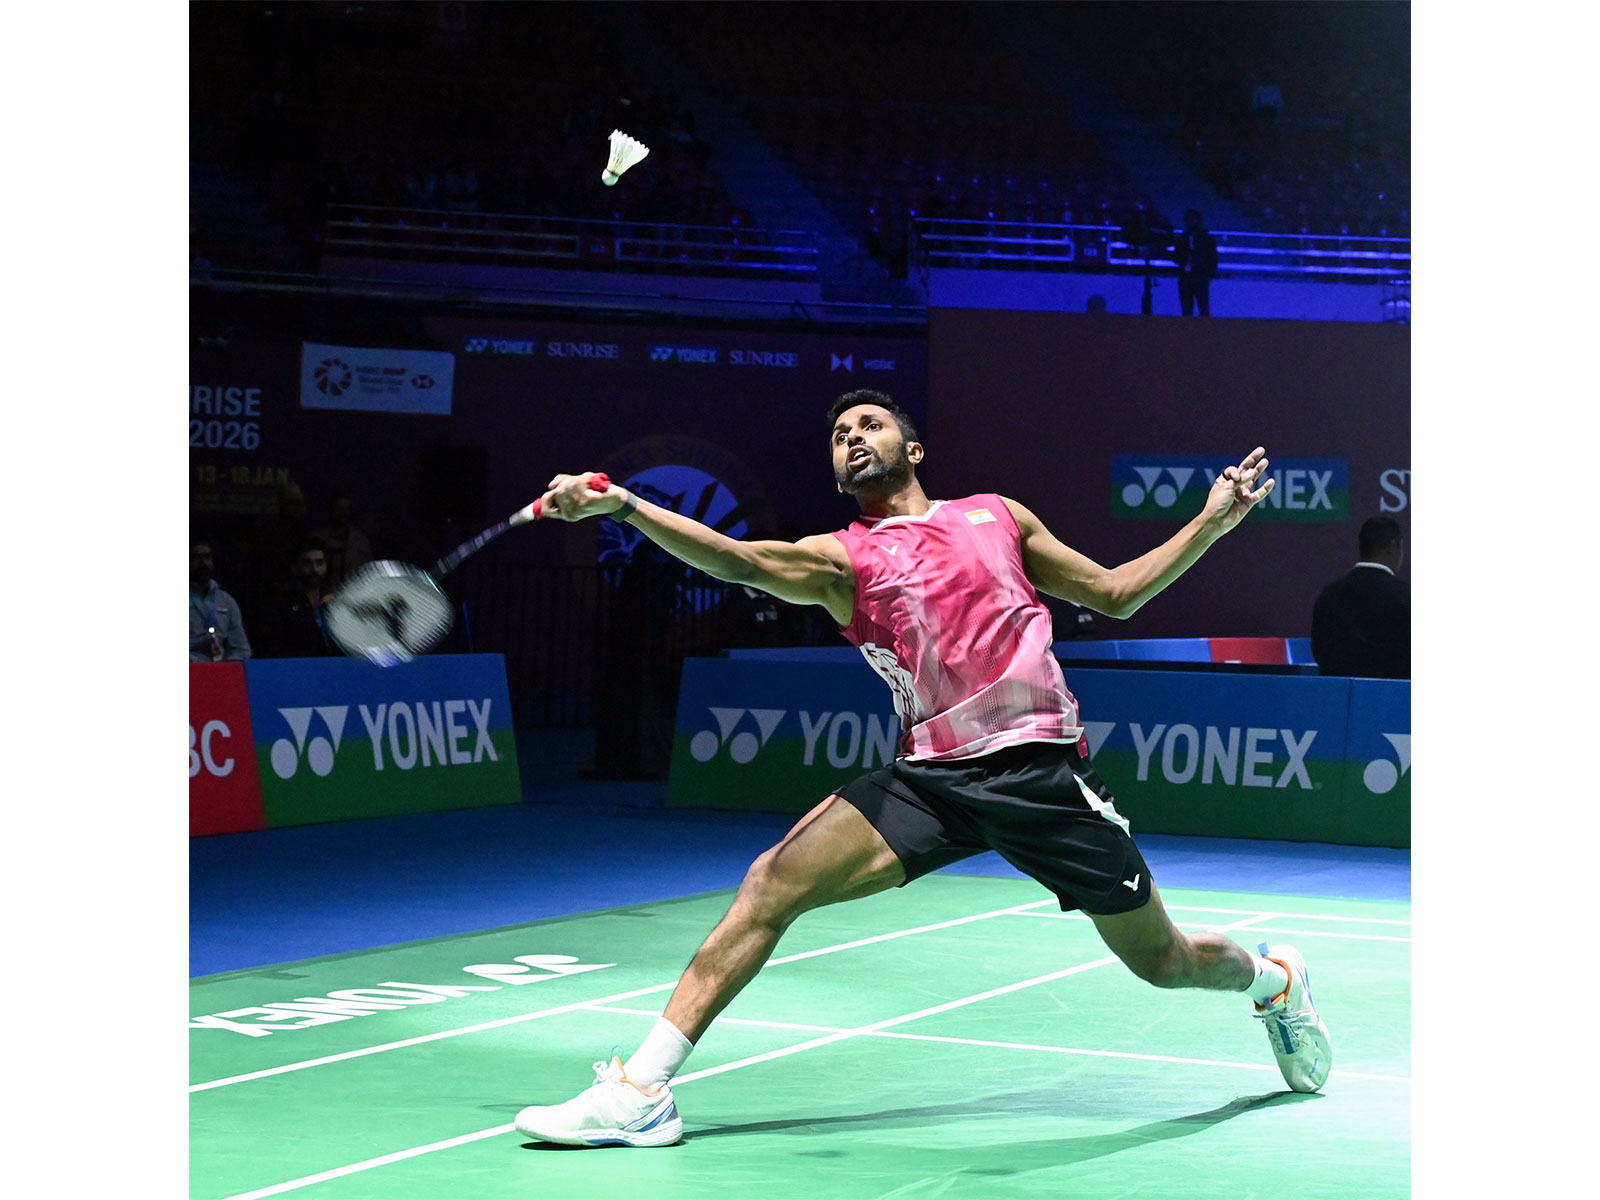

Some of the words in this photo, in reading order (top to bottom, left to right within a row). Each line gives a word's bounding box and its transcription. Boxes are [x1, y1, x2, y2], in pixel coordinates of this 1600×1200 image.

[492, 340, 534, 355] YONEX
[547, 341, 619, 359] SUNRISE
[677, 348, 717, 363] YONEX
[729, 350, 798, 367] SUNRISE
[189, 419, 261, 450] 2026
[1203, 467, 1333, 510] NEX
[358, 698, 499, 771] YONEX
[1128, 722, 1319, 790] YONEX
[189, 981, 503, 1037] YONEX
